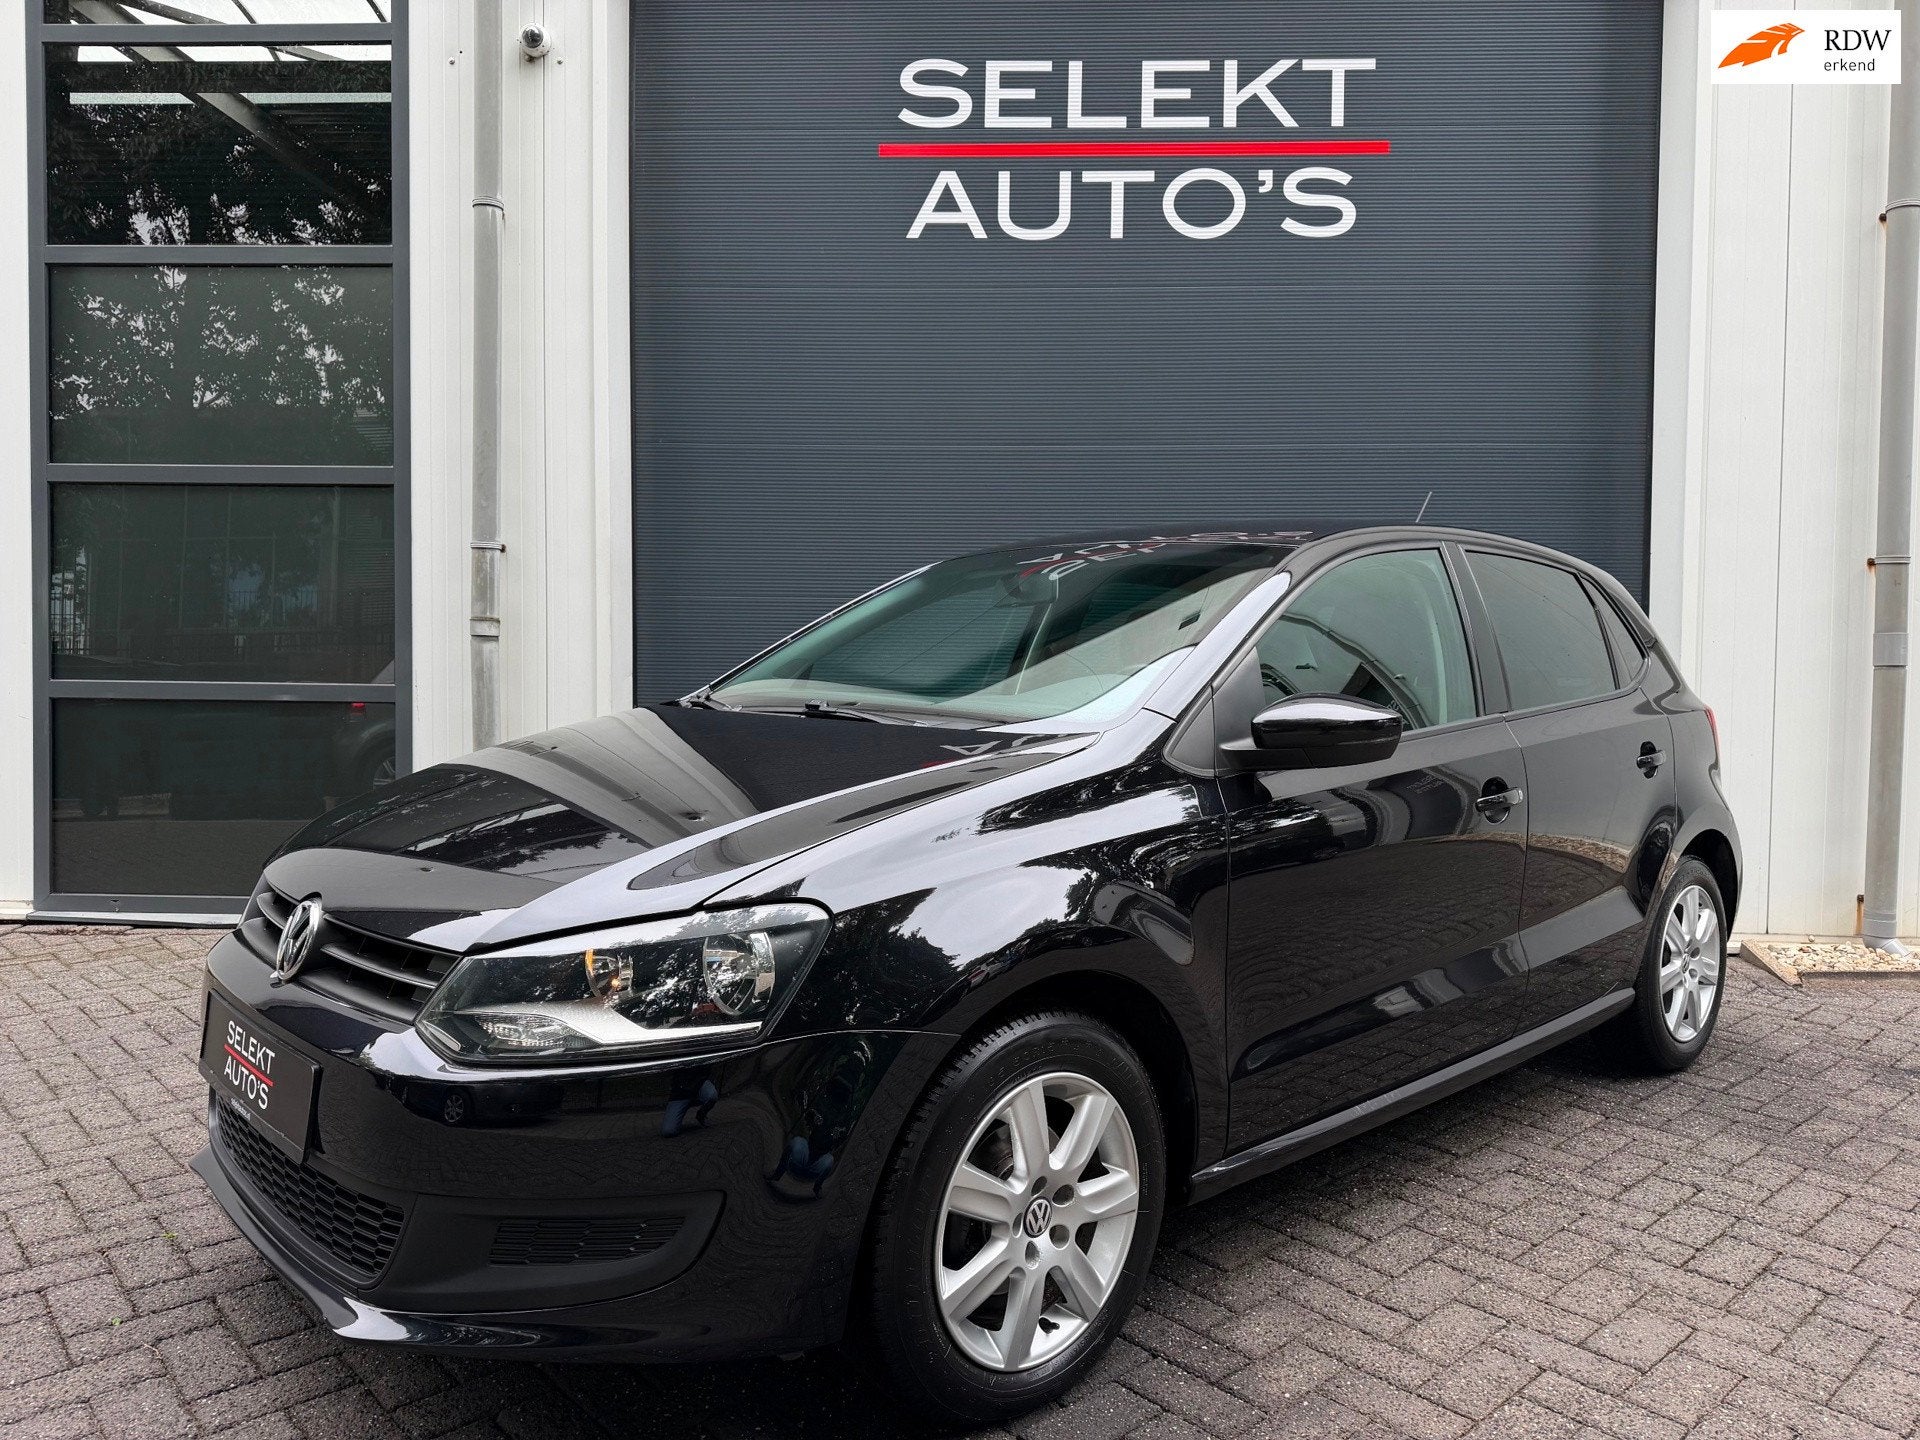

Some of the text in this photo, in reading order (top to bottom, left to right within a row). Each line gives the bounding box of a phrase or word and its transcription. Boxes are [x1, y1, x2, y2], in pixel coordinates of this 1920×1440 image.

[897, 57, 1377, 129] SELEKT
[905, 166, 1357, 241] AUTO'S
[226, 1020, 276, 1075] SELEKT
[223, 1055, 269, 1110] AUTO'S
